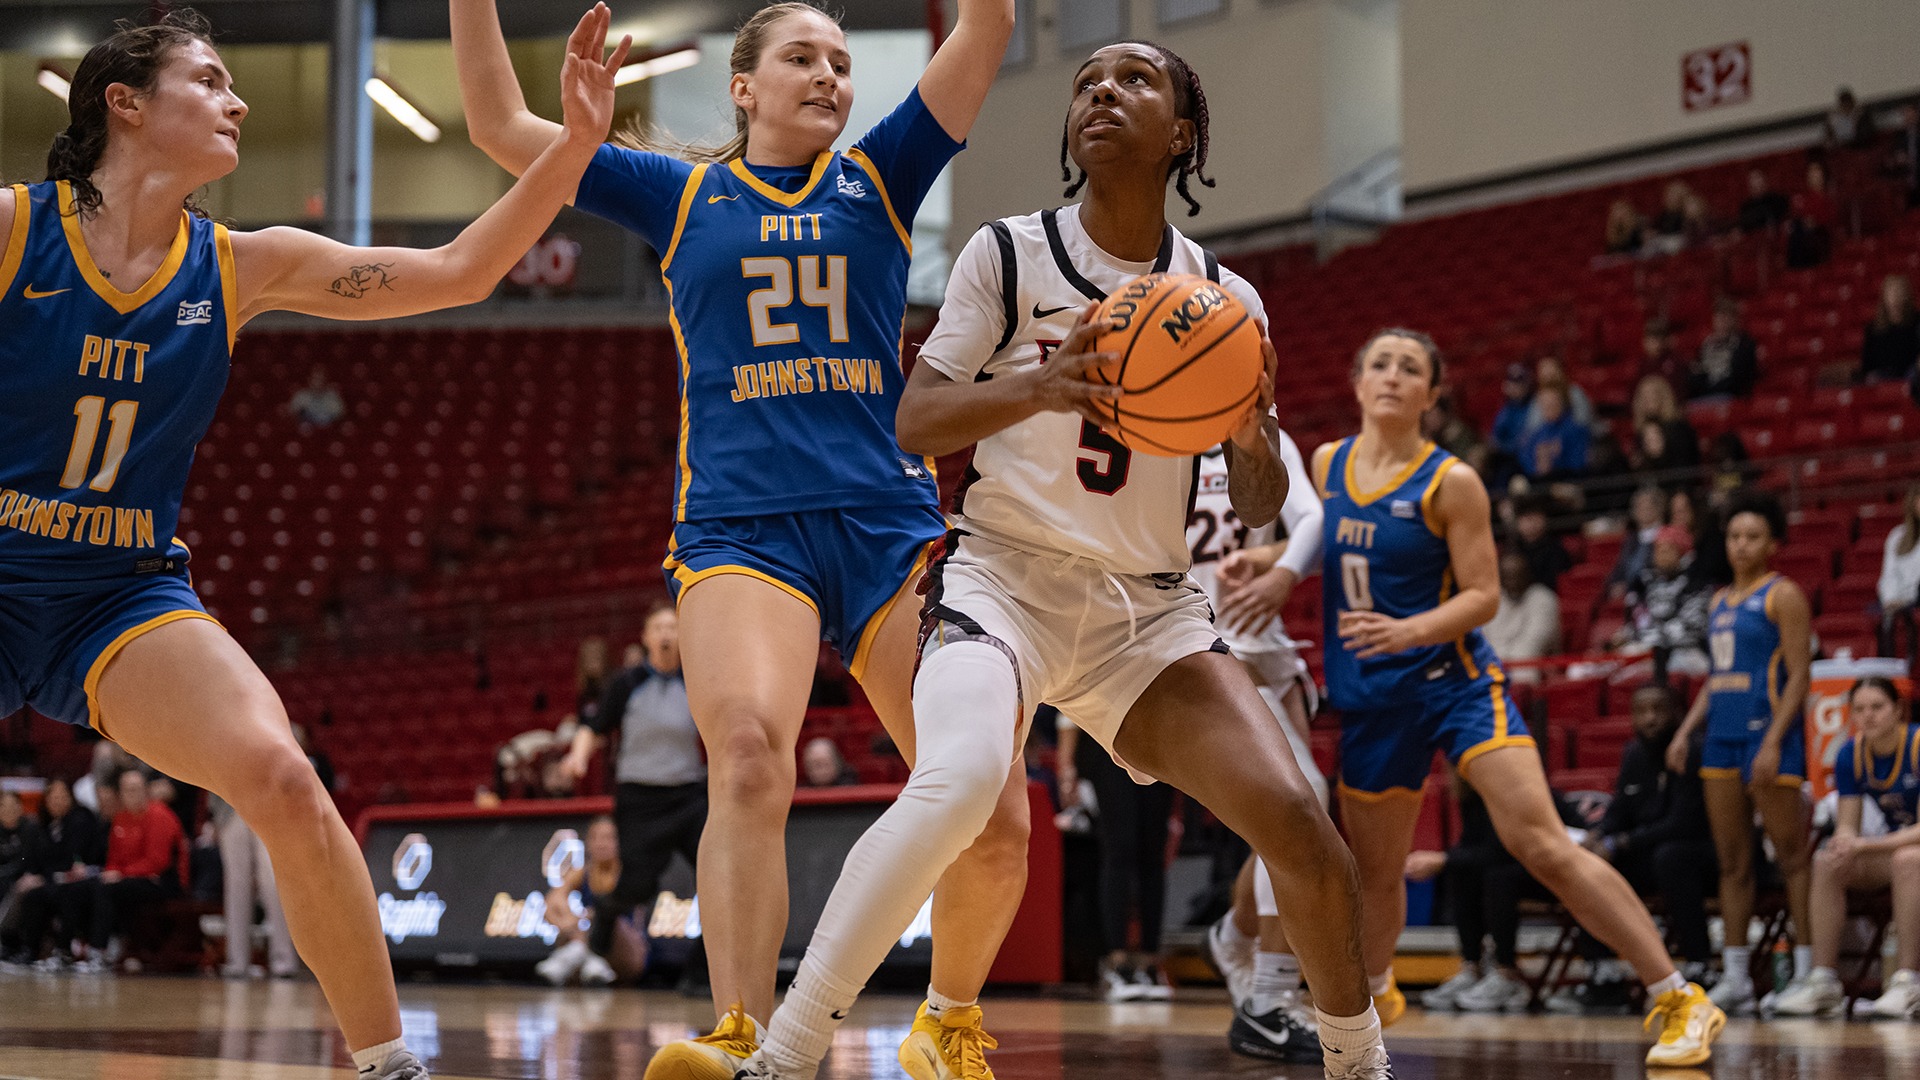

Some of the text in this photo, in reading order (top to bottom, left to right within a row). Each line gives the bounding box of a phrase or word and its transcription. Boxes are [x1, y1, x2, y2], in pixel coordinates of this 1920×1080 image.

[1687, 45, 1746, 110] 32
[760, 213, 823, 242] PITT
[177, 306, 213, 319] PSAC
[740, 255, 850, 348] 24
[1160, 284, 1231, 344] NCAA
[78, 334, 150, 383] PITT
[730, 356, 884, 403] JOHNSTOWN
[58, 395, 139, 493] 11
[1076, 415, 1133, 496] 5
[0, 487, 155, 548] OHNSTOWN
[1188, 508, 1250, 564] 23
[1336, 516, 1378, 549] PITT
[1341, 552, 1375, 612] 0
[1815, 696, 1843, 734] G
